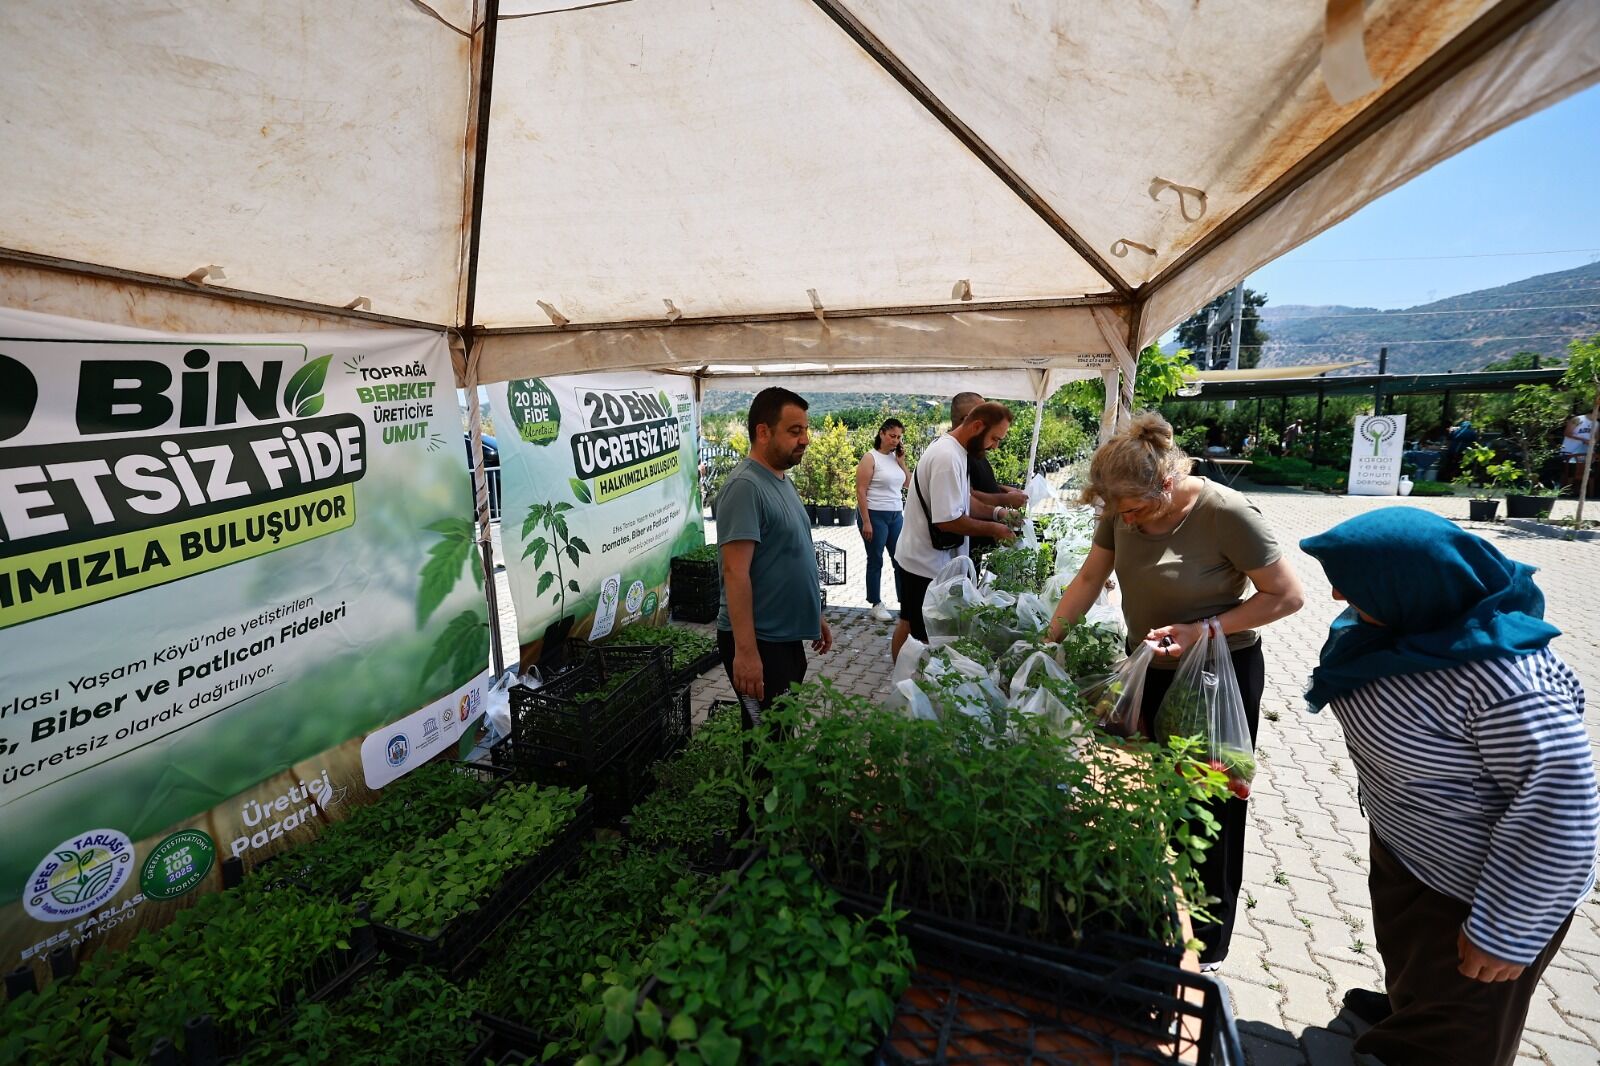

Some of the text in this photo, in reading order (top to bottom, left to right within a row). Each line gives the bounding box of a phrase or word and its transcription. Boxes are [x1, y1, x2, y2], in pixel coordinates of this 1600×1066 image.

[360, 361, 427, 381] TOPRAĞA
[356, 382, 436, 403] BEREKET
[514, 387, 552, 407] 20 BİN
[373, 402, 434, 423] ÜRETİCİYE
[524, 407, 550, 423] FİDE
[584, 392, 625, 428] 20
[382, 422, 428, 444] UMUT
[577, 421, 680, 474] ÜCRETSİZ FİDE
[0, 426, 362, 543] ETSİZ FİDE
[599, 467, 649, 495] HALKIMIZLA
[180, 495, 346, 560] BULUŞUYOR
[1, 597, 313, 719] rlası Yaşam Köyü'nde yetiştirilen
[31, 693, 127, 742] Biber
[135, 679, 170, 703] ve
[177, 636, 274, 687] Patlıcan
[280, 601, 346, 643] Fideleri
[2, 664, 274, 784] ücretsiz olarak dağıtılıyor.
[242, 769, 331, 827] Üretici
[230, 803, 317, 858] Pazarı
[34, 834, 125, 894] EFES TARLASI
[147, 854, 162, 880] GREEN
[161, 836, 209, 854] DESTINATIONS
[163, 846, 190, 864] TOP
[165, 854, 193, 876] 100
[165, 872, 200, 895] STORIES
[169, 864, 193, 883] 2025
[21, 929, 70, 961] EFES
